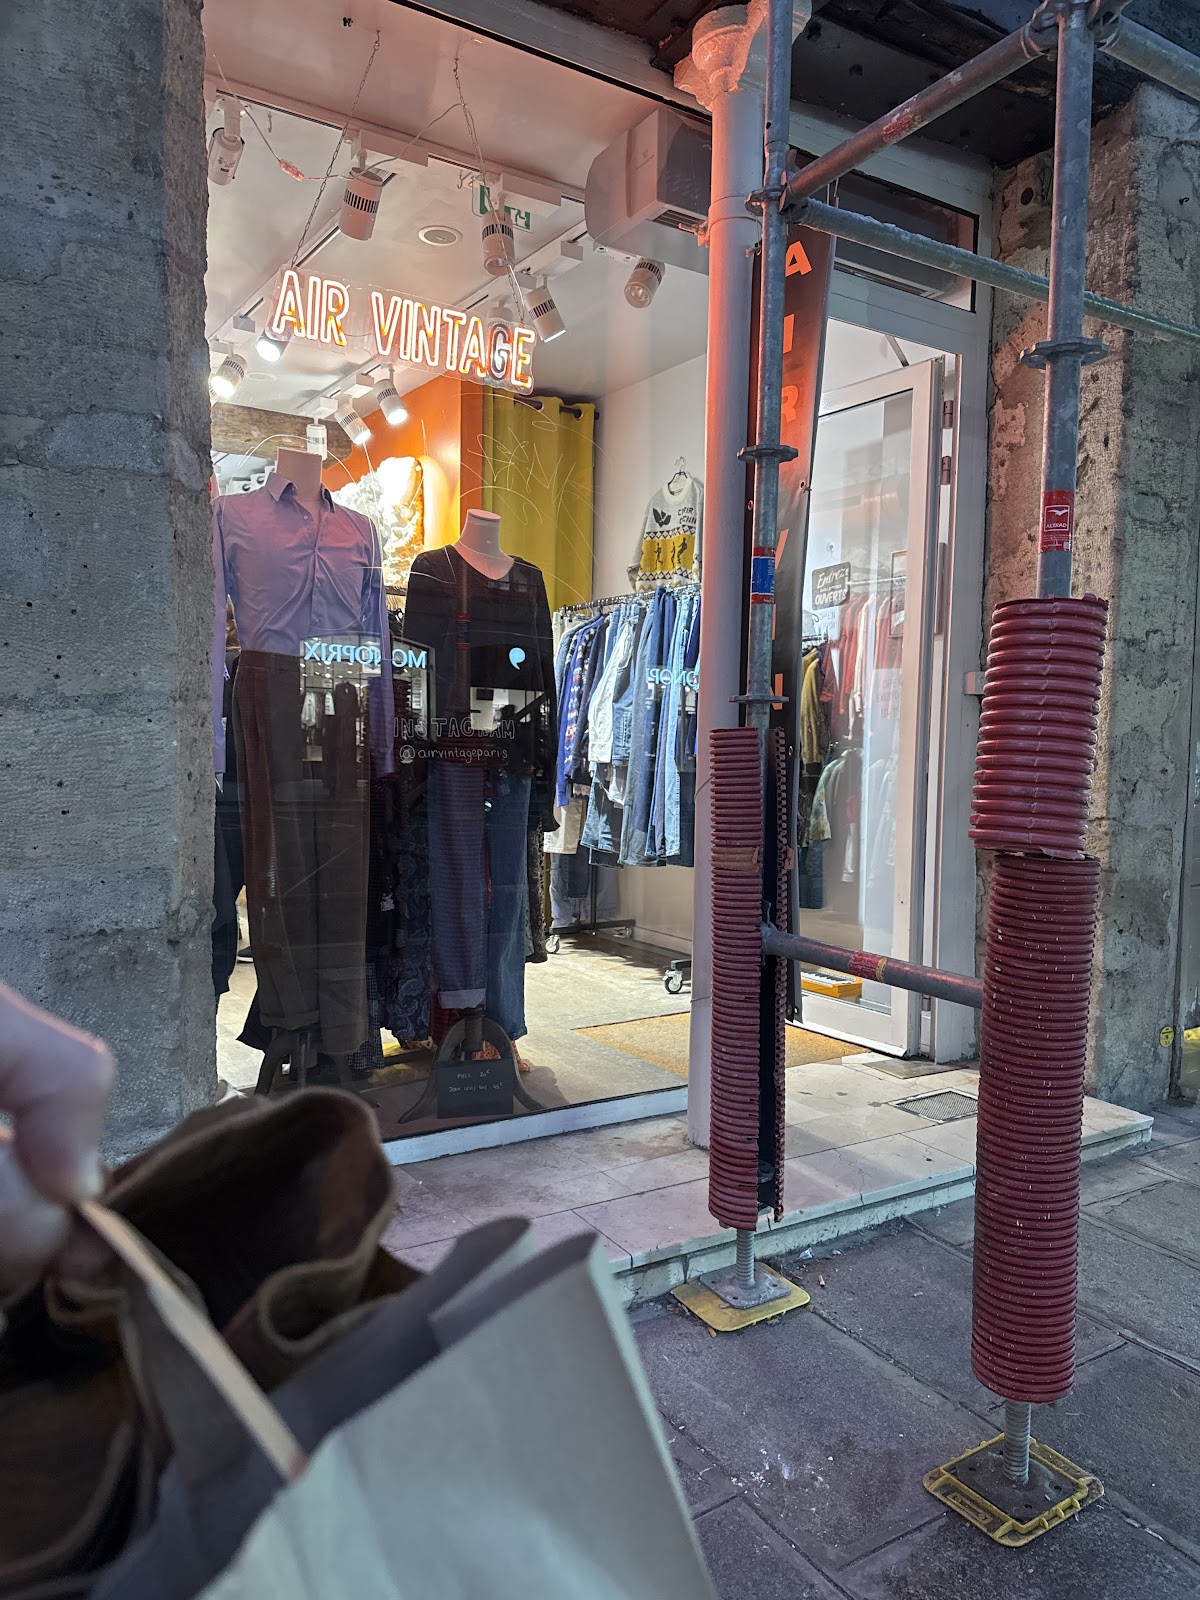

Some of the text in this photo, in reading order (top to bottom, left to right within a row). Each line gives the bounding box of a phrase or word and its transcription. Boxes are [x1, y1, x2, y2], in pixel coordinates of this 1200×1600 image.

[272, 270, 536, 388] AIR VINTAGE
[815, 589, 847, 605] OUVERTS
[400, 744, 508, 763] @airvintageparis
